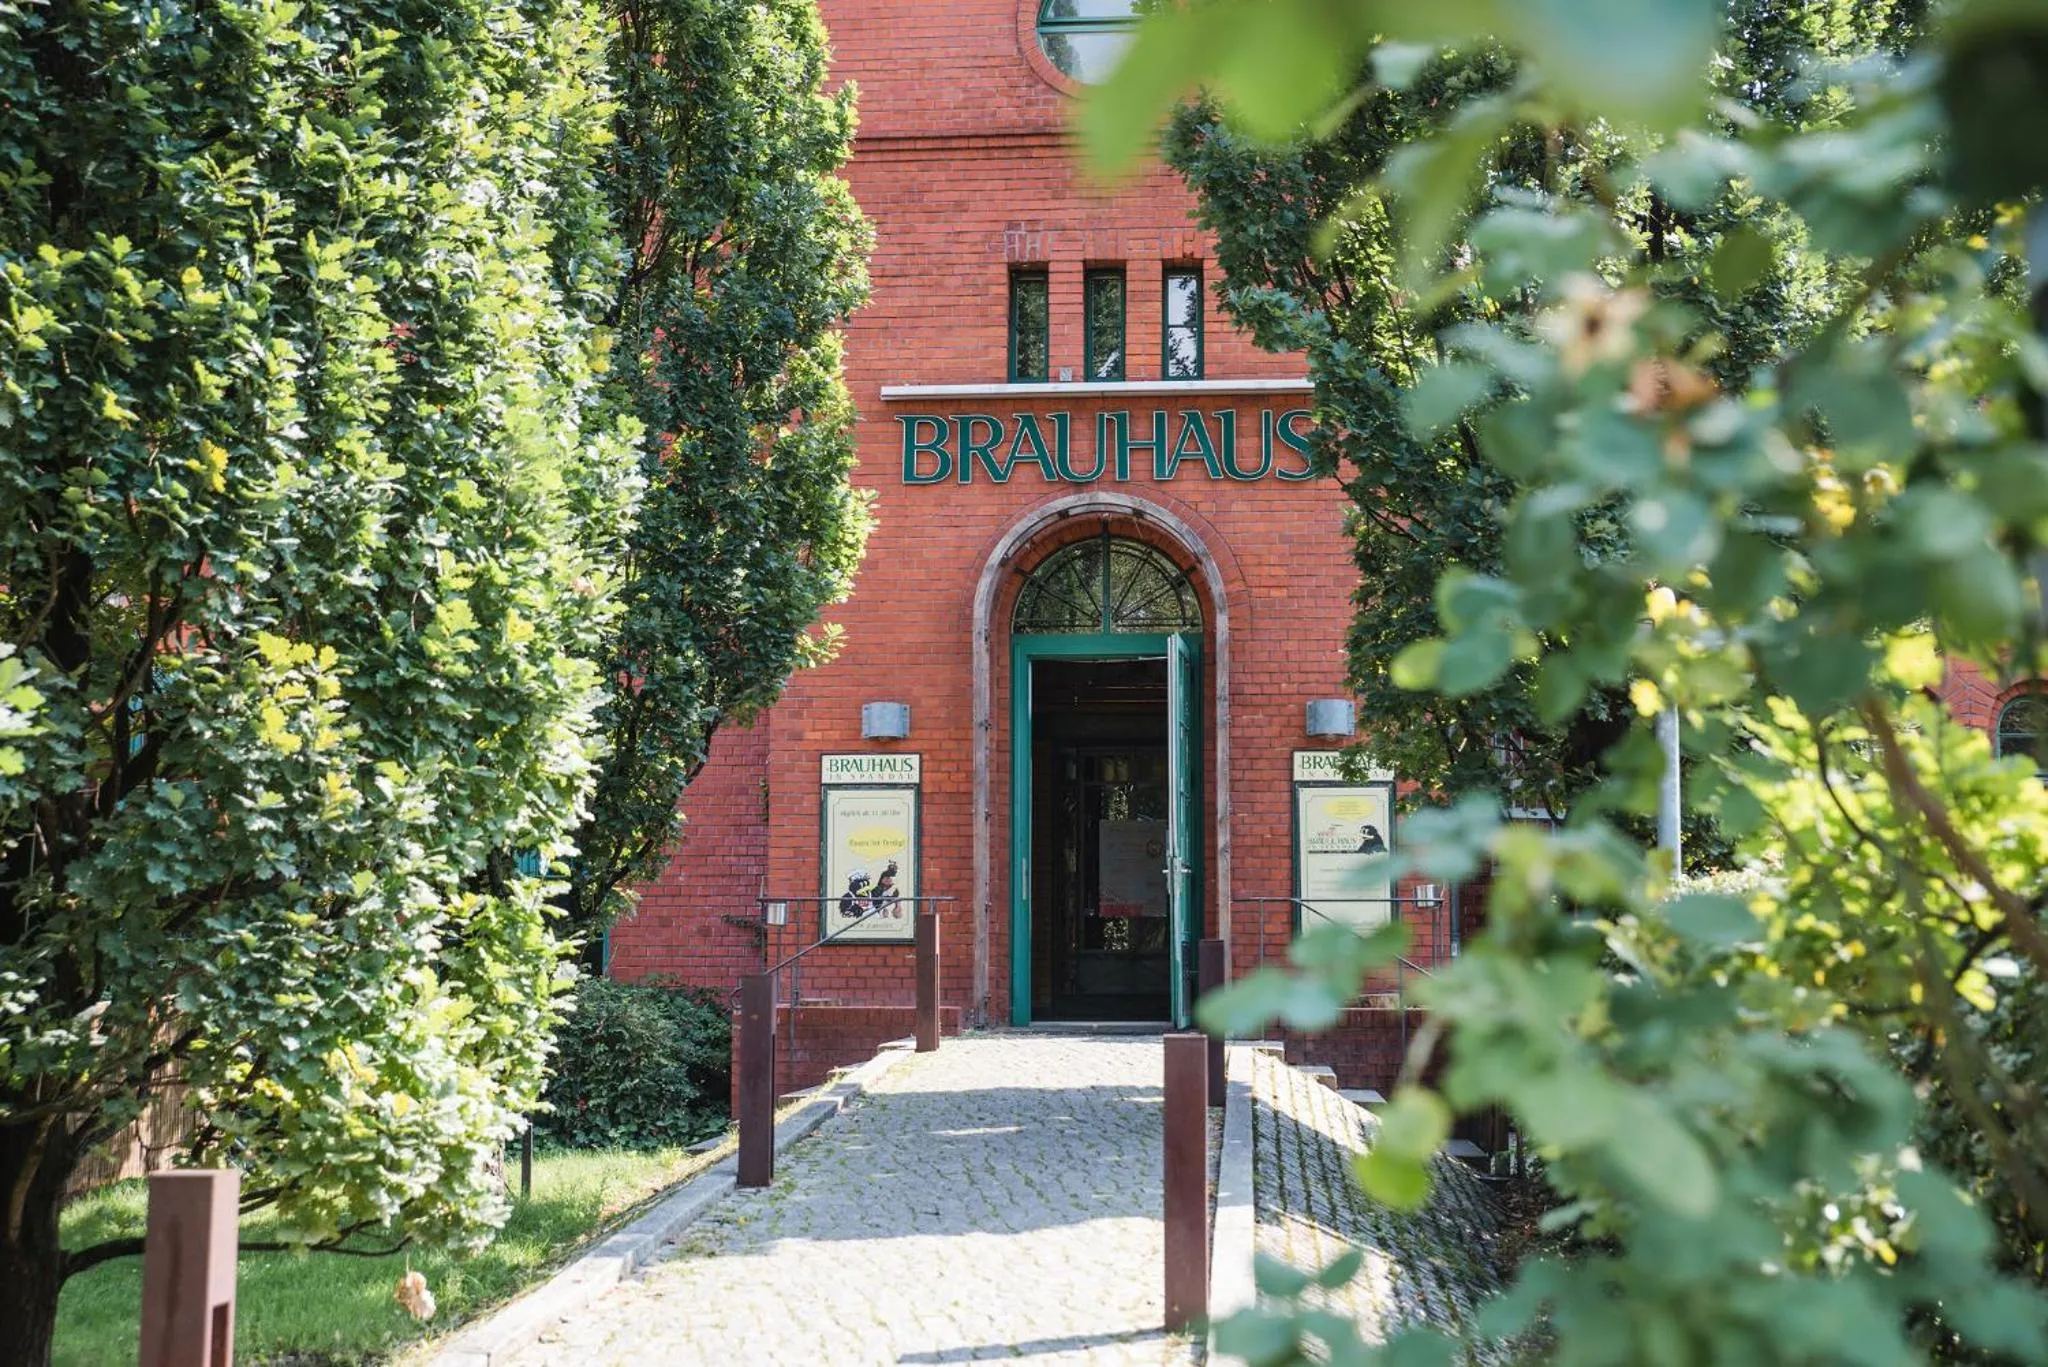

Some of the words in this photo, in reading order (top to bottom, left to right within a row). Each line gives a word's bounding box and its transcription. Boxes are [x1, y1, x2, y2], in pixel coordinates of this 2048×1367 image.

[894, 409, 1318, 486] BRAUHAUS
[829, 757, 913, 772] BRAUHAUS
[830, 773, 842, 781] IN
[851, 773, 914, 781] SPANDAU
[1324, 771, 1387, 779] SPAU
